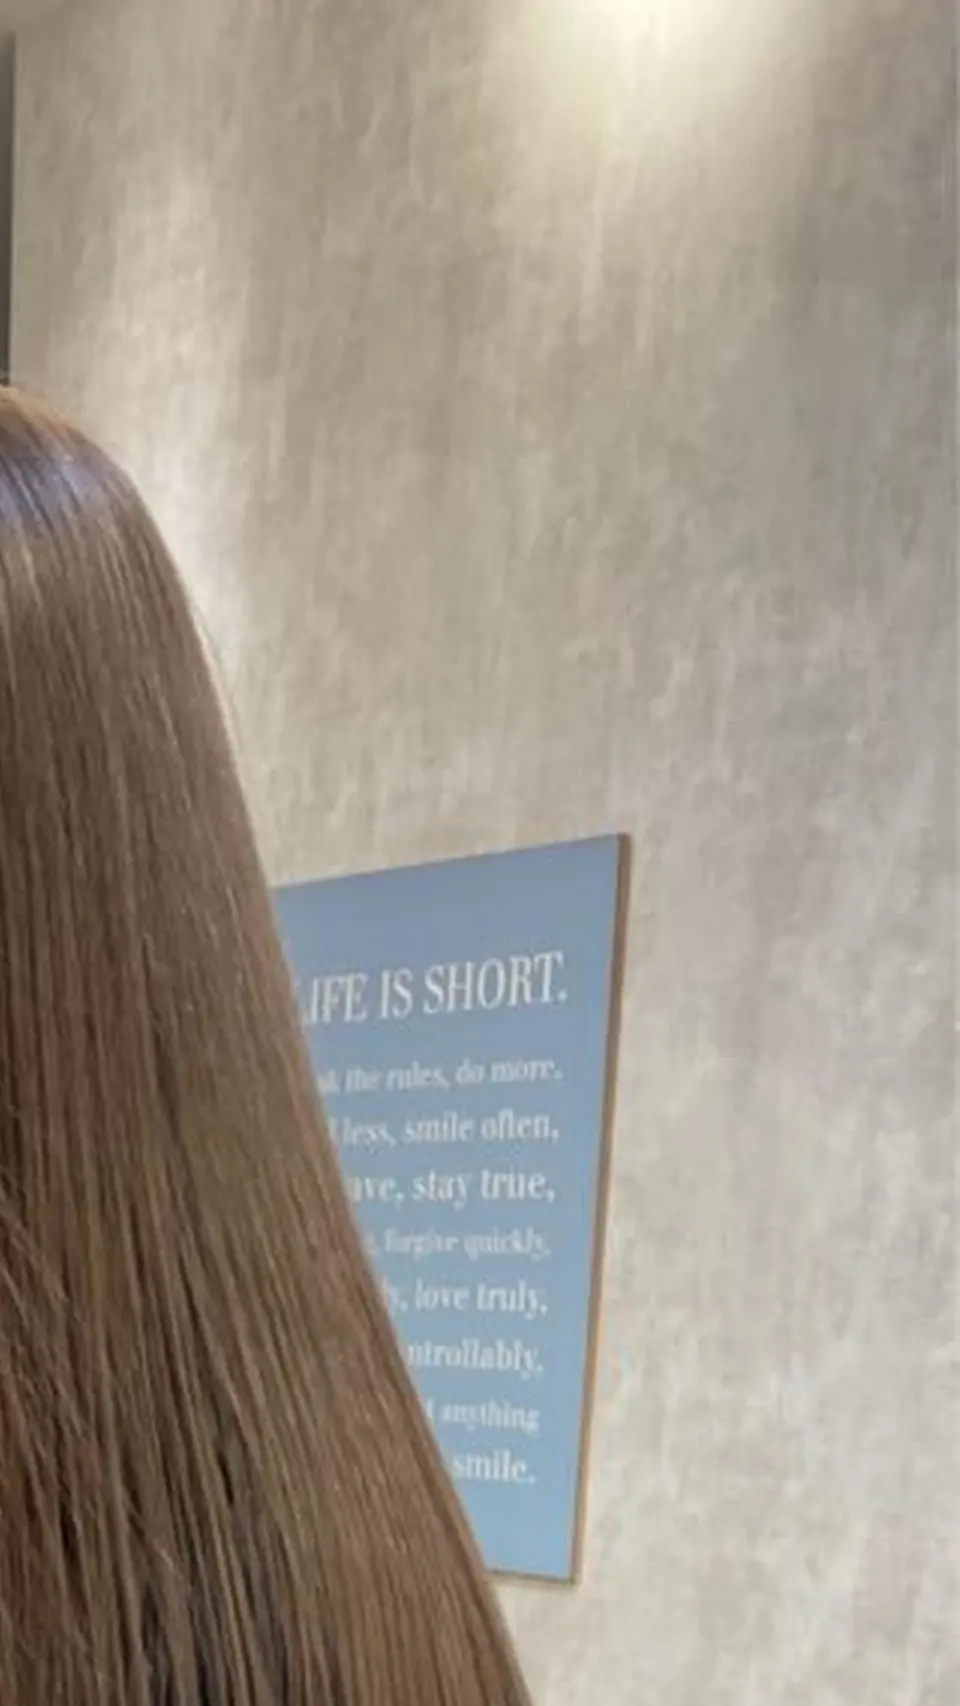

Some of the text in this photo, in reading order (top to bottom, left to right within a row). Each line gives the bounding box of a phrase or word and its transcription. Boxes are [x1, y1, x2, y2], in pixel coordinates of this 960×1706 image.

[379, 967, 414, 1020] IS
[422, 950, 569, 1015] SHORT.
[344, 1065, 382, 1093] the
[455, 1058, 485, 1086] do
[403, 1109, 476, 1143] smile
[481, 1107, 560, 1144] often,
[346, 1167, 557, 1210] ave, stay true,
[385, 1227, 459, 1262] forgive
[414, 1277, 470, 1312] love
[476, 1277, 549, 1321] truly,
[407, 1338, 544, 1382] ntrollably.
[441, 1400, 541, 1436] anything
[451, 1449, 537, 1484] smile.
